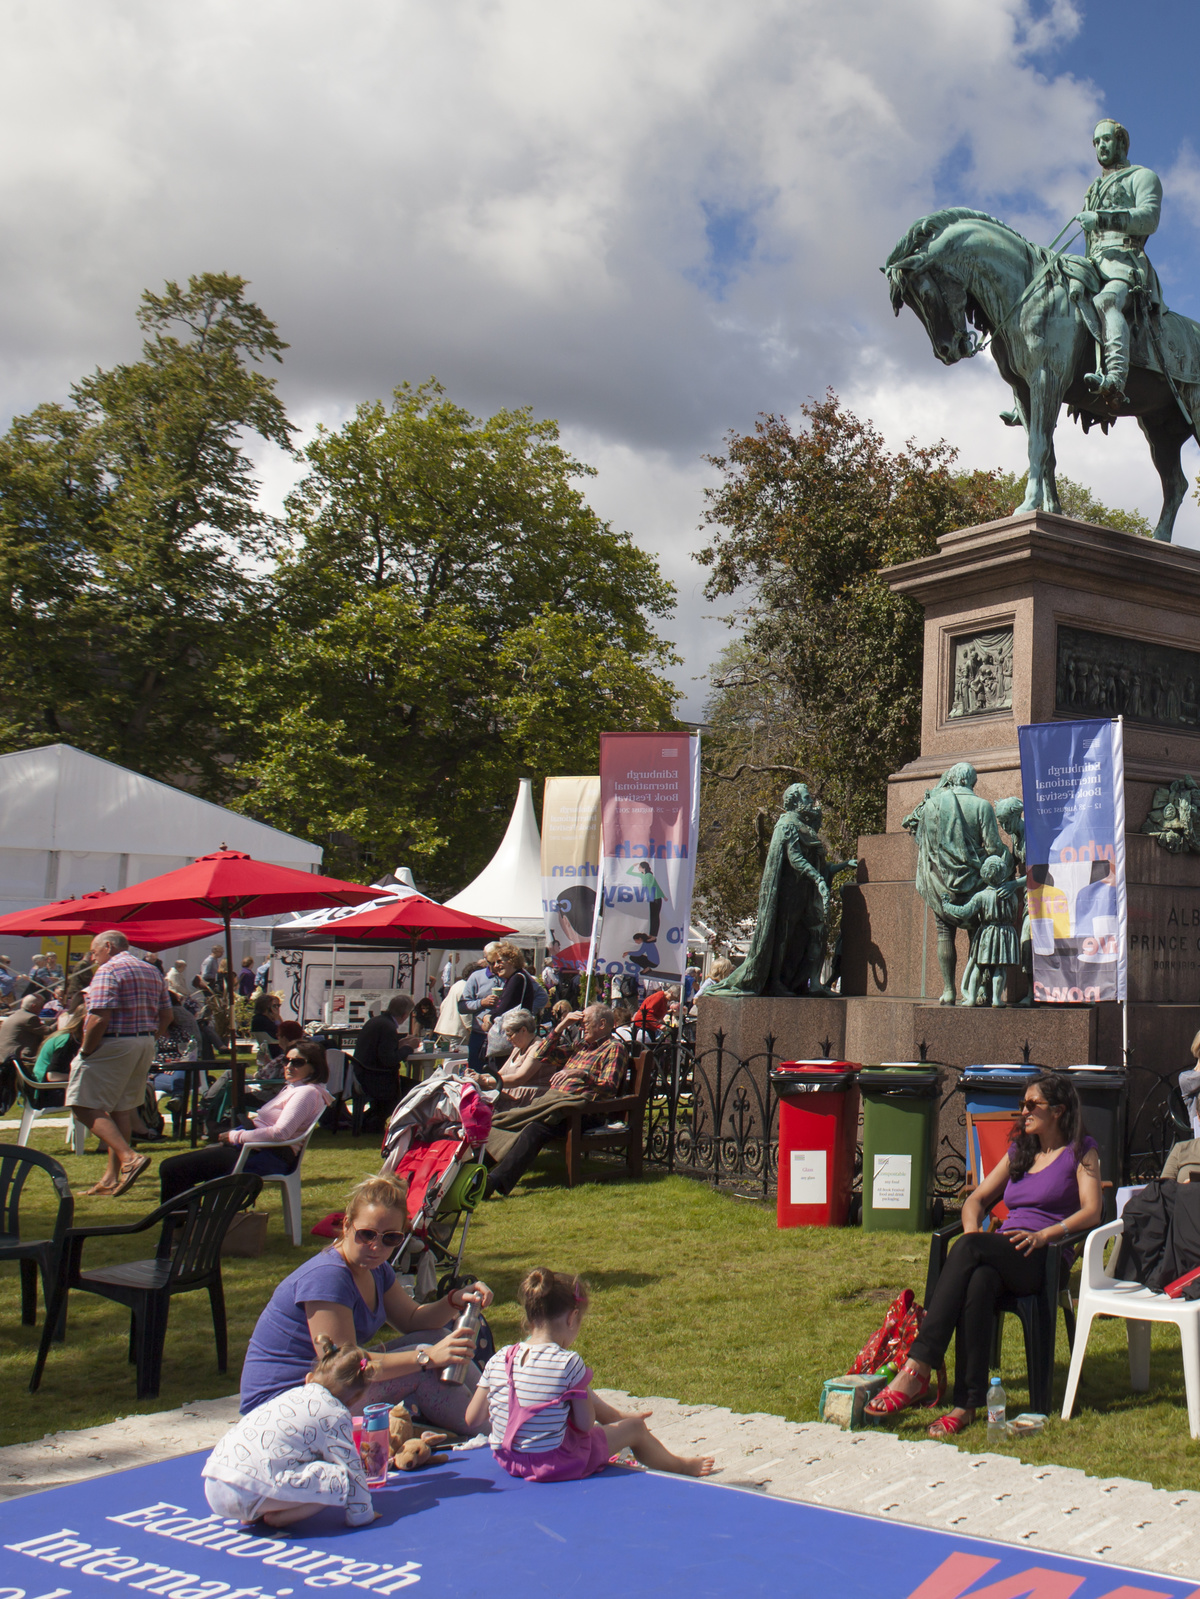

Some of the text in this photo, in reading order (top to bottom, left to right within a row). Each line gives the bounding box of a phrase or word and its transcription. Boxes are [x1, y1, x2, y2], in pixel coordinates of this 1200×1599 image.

[1130, 934, 1188, 950] PRINCE
[1154, 960, 1175, 970] BORN
[106, 1502, 422, 1596] Edinburgh
